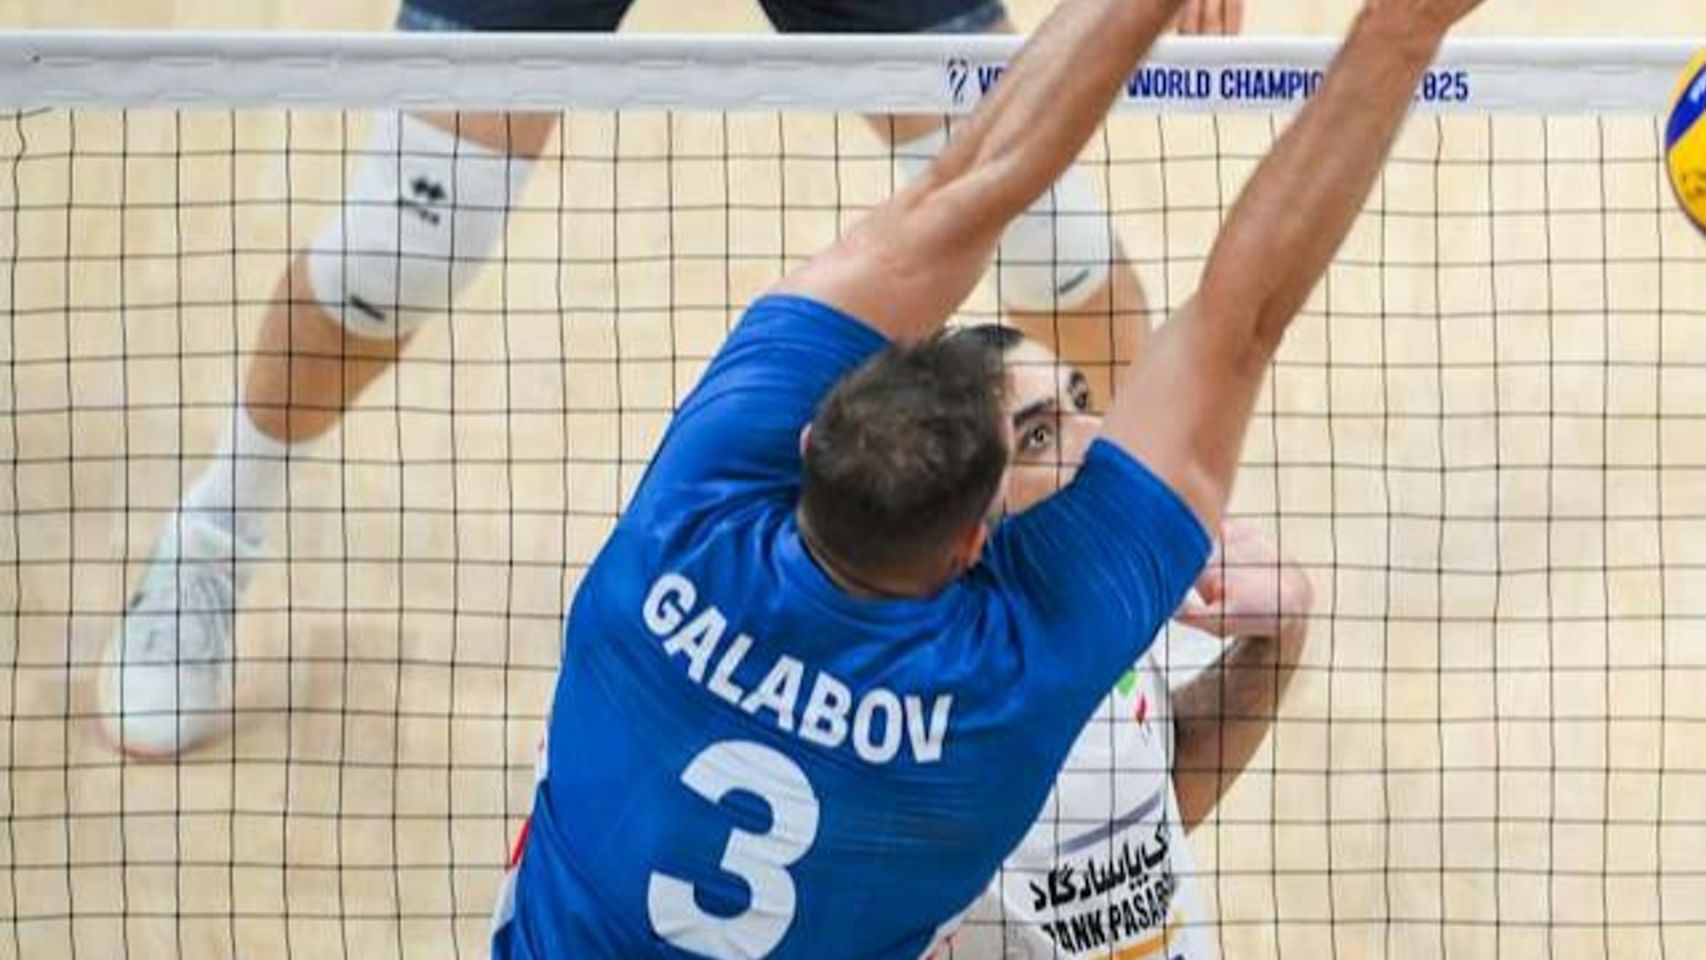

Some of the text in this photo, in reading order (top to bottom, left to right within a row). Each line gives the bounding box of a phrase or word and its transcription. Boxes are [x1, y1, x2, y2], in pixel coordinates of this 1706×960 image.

[1126, 68, 1210, 99] WORLD
[1415, 72, 1469, 102] 025
[642, 572, 953, 765] GALABOV
[648, 739, 820, 960] 3
